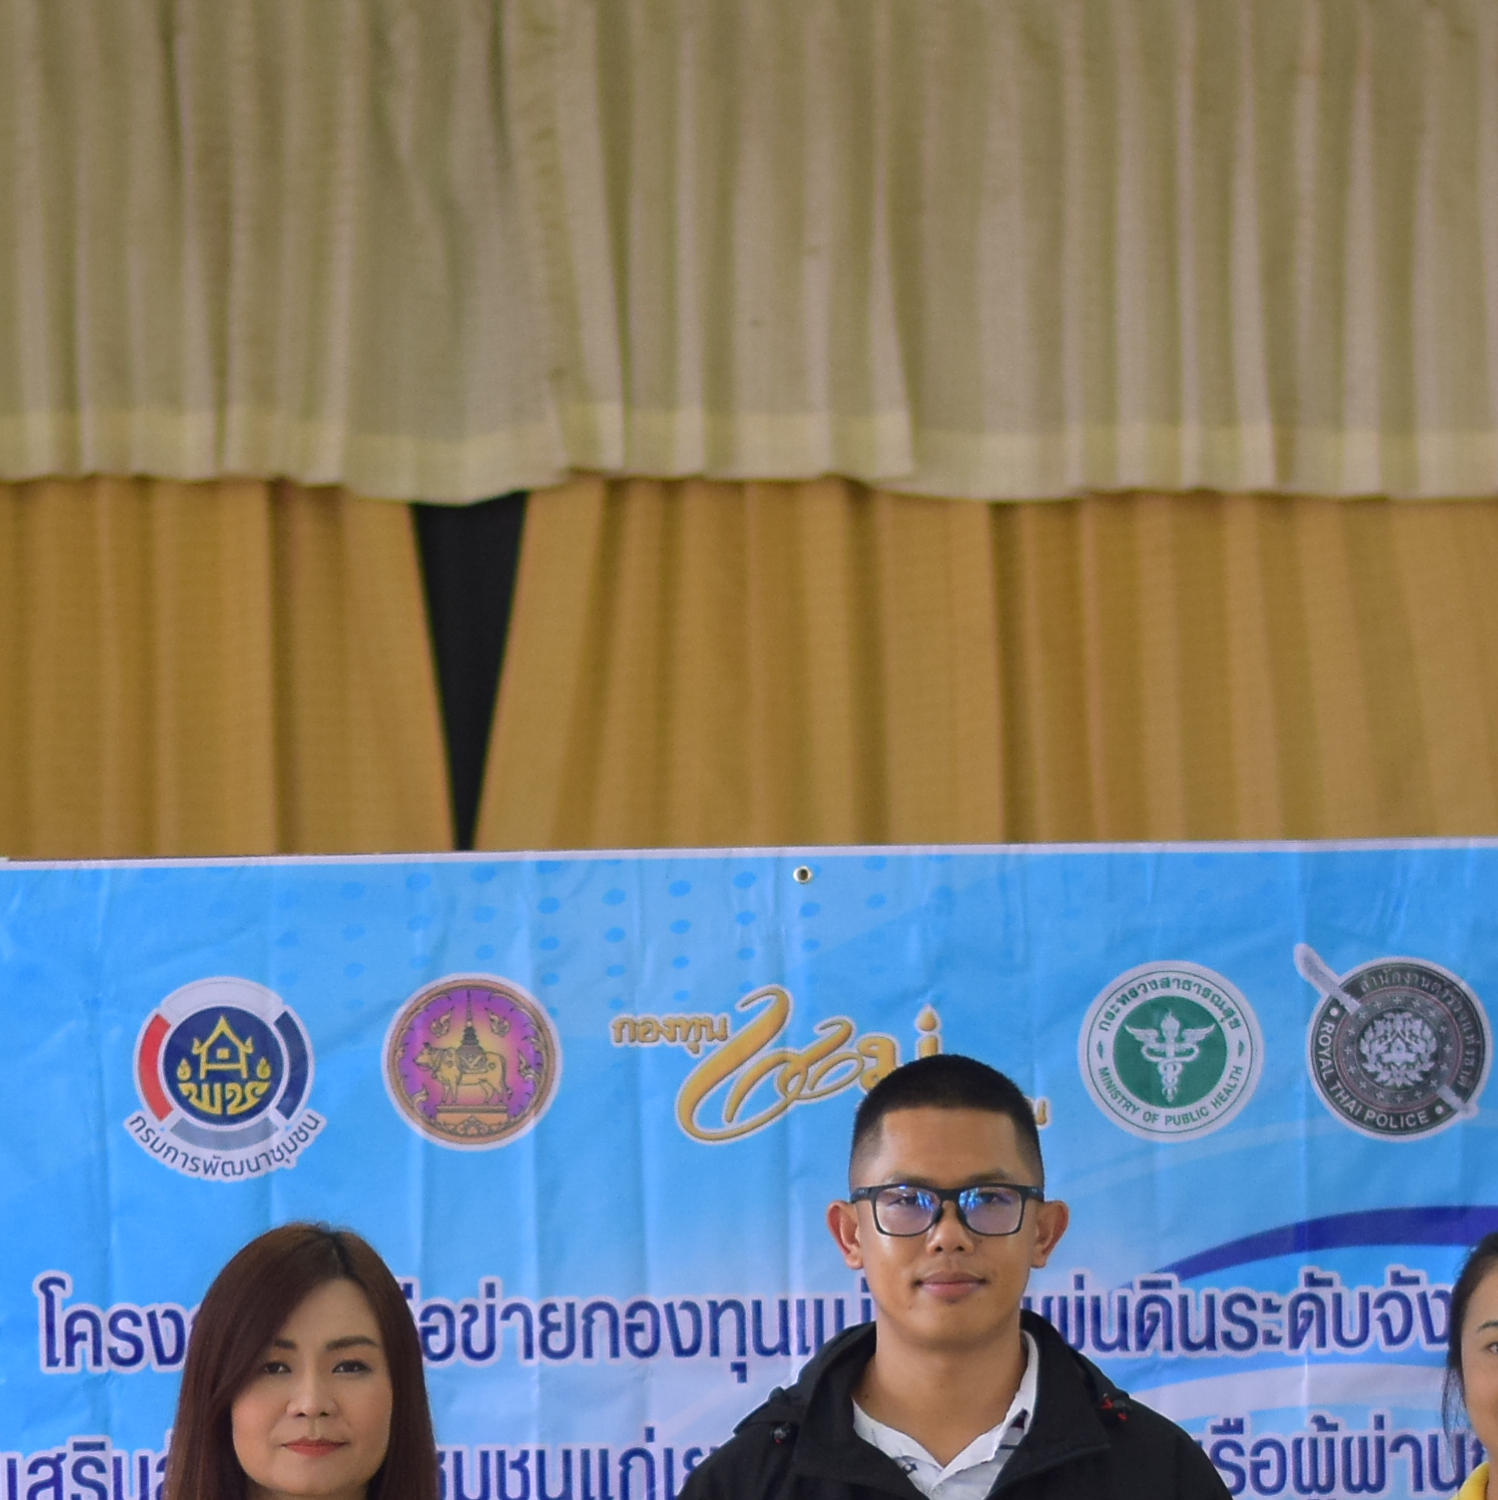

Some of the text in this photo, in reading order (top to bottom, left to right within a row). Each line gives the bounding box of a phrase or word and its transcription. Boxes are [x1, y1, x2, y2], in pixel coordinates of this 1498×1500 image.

[612, 1015, 729, 1054] กองทุน
[1098, 1065, 1244, 1127] MINISTRY OF PUBLIC HEALTH
[1318, 1021, 1430, 1130] ROYAL THAI POLICE
[129, 1112, 321, 1178] กรมการพัฒนาชุมชน
